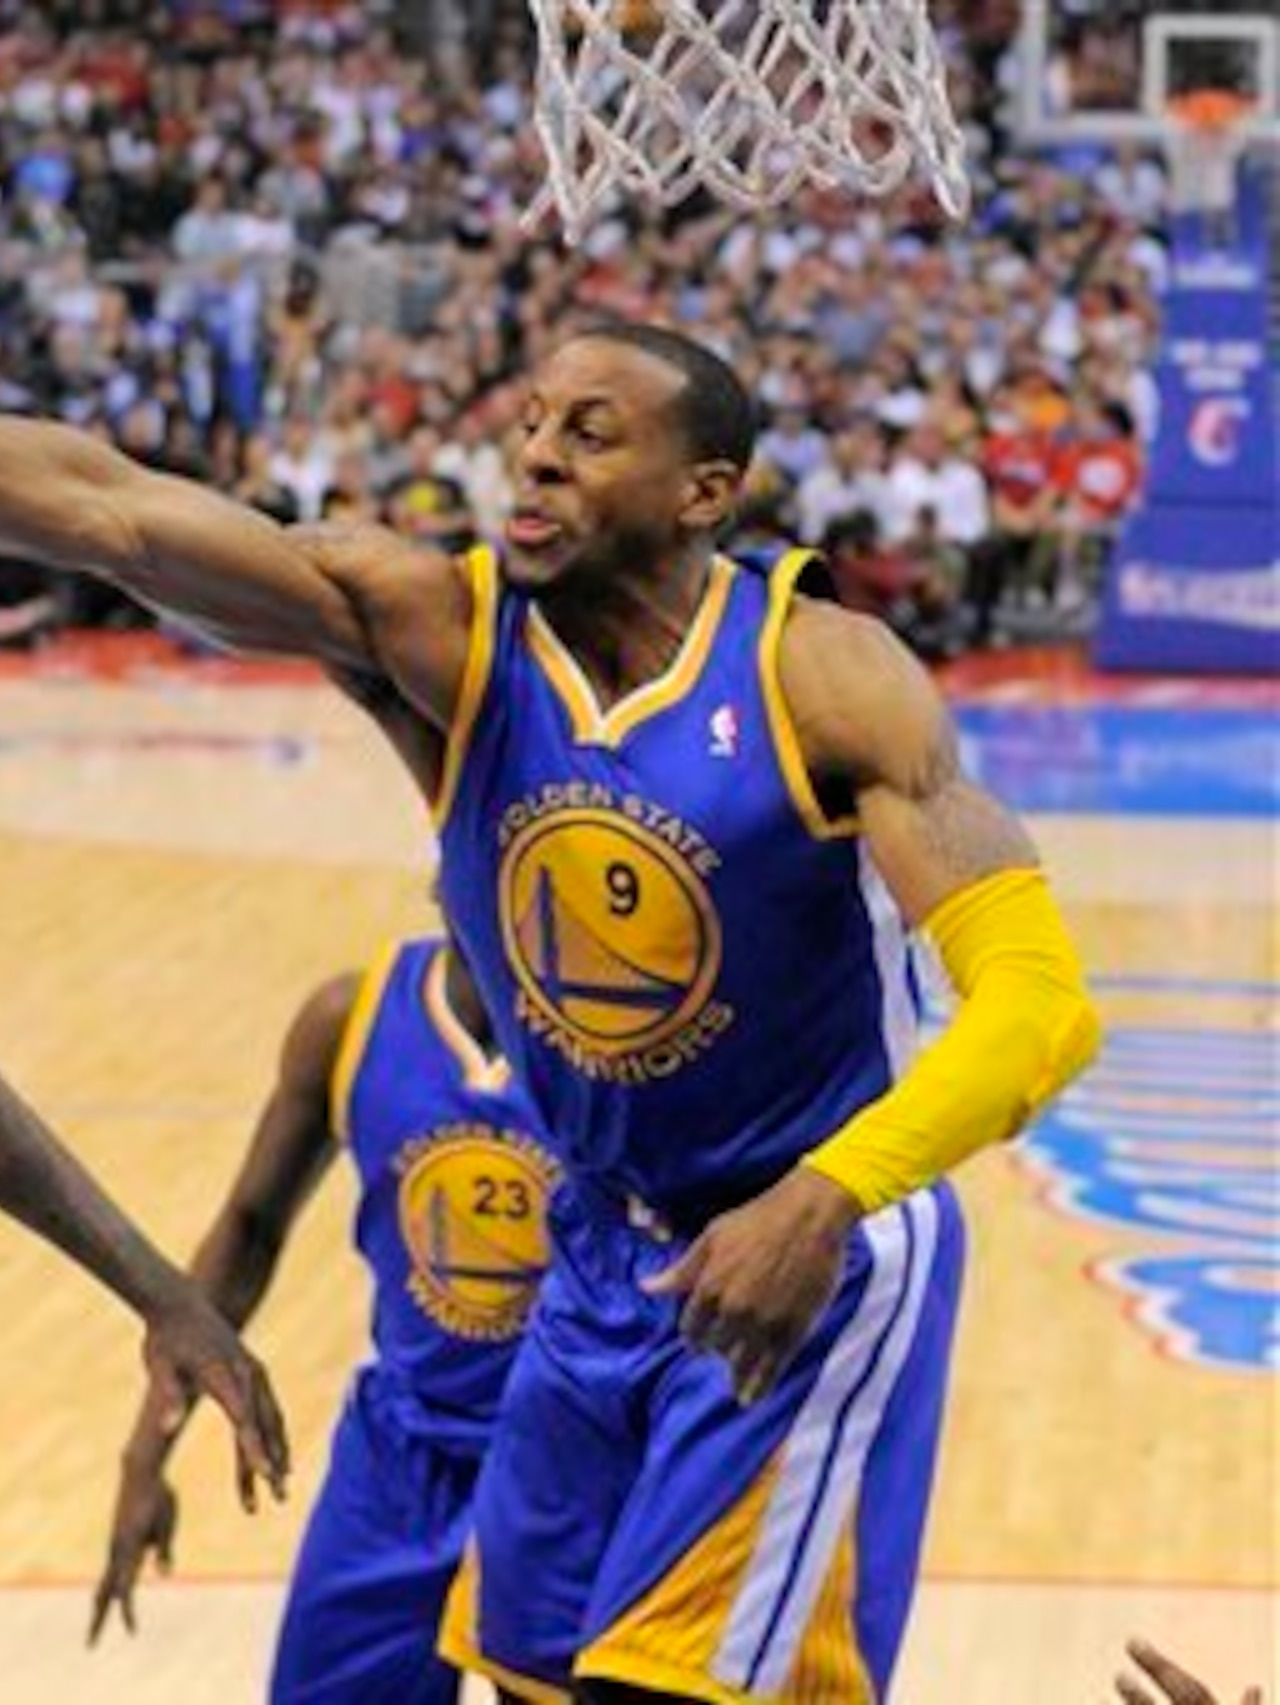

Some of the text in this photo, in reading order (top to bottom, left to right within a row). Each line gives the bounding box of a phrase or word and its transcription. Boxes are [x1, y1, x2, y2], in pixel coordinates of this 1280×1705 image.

[499, 781, 722, 875] GOLDEN STATE
[605, 861, 640, 917] 9
[515, 991, 734, 1083] WARRIORS
[472, 1175, 532, 1221] 23
